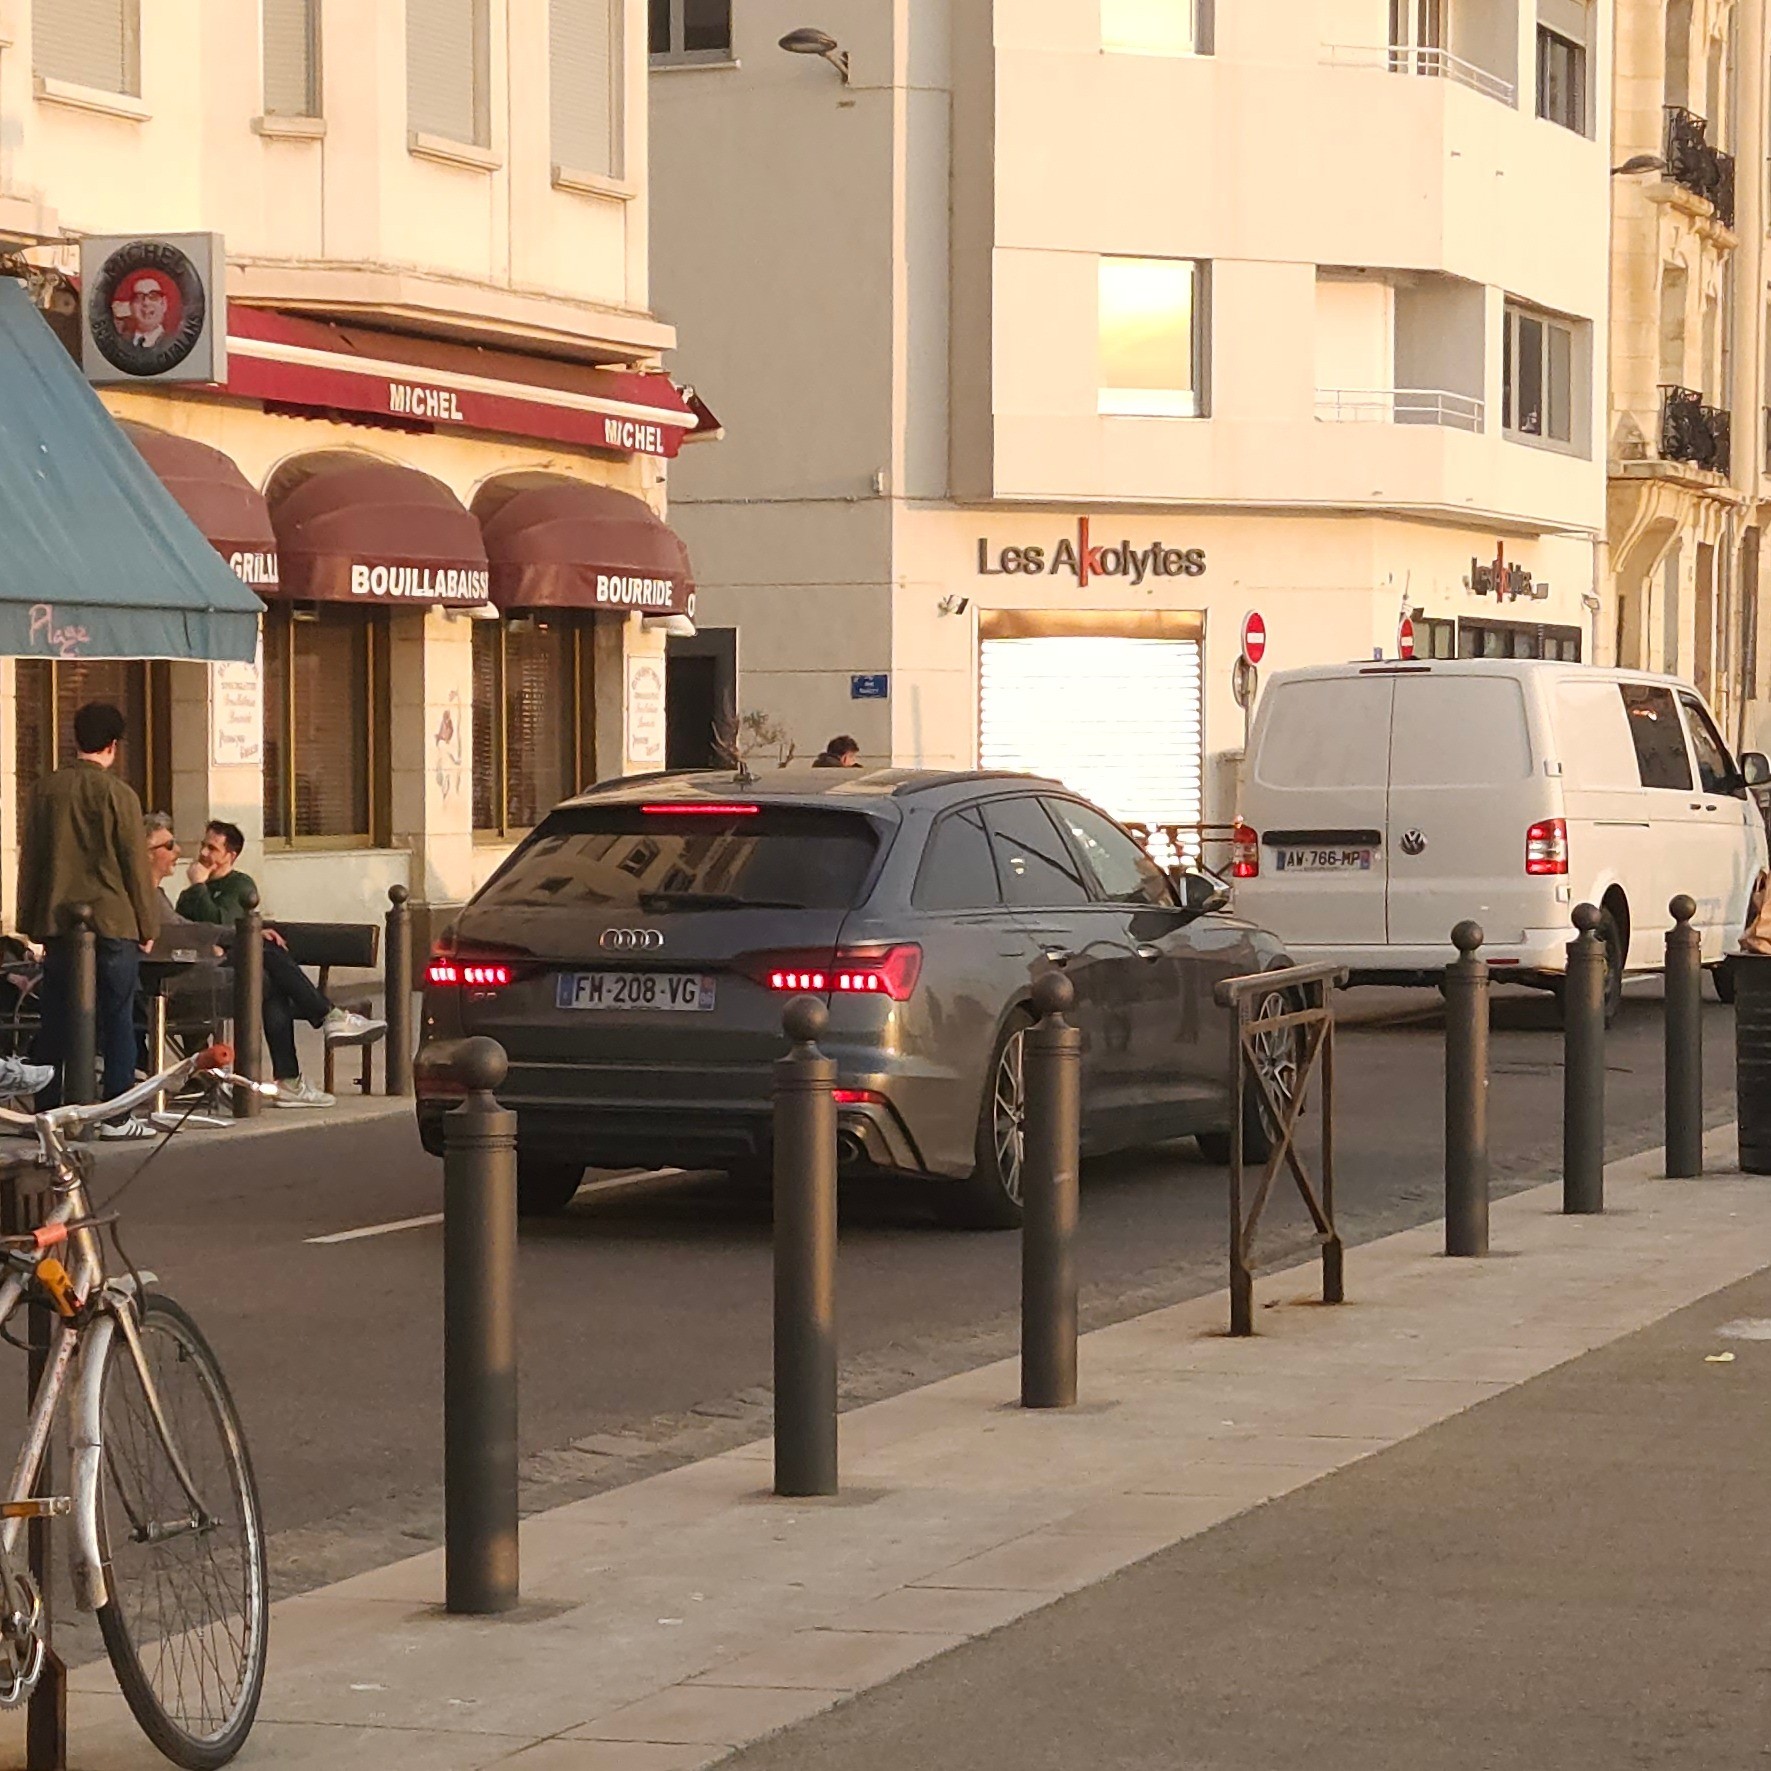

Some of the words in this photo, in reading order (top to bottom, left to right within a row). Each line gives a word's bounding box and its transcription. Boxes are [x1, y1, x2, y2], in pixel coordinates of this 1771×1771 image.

[390, 383, 463, 421] MICHEL
[604, 419, 664, 453] MICHEL
[978, 538, 1045, 575] Les
[1048, 516, 1207, 587] Akolytes
[596, 575, 673, 607] BOURRIDE
